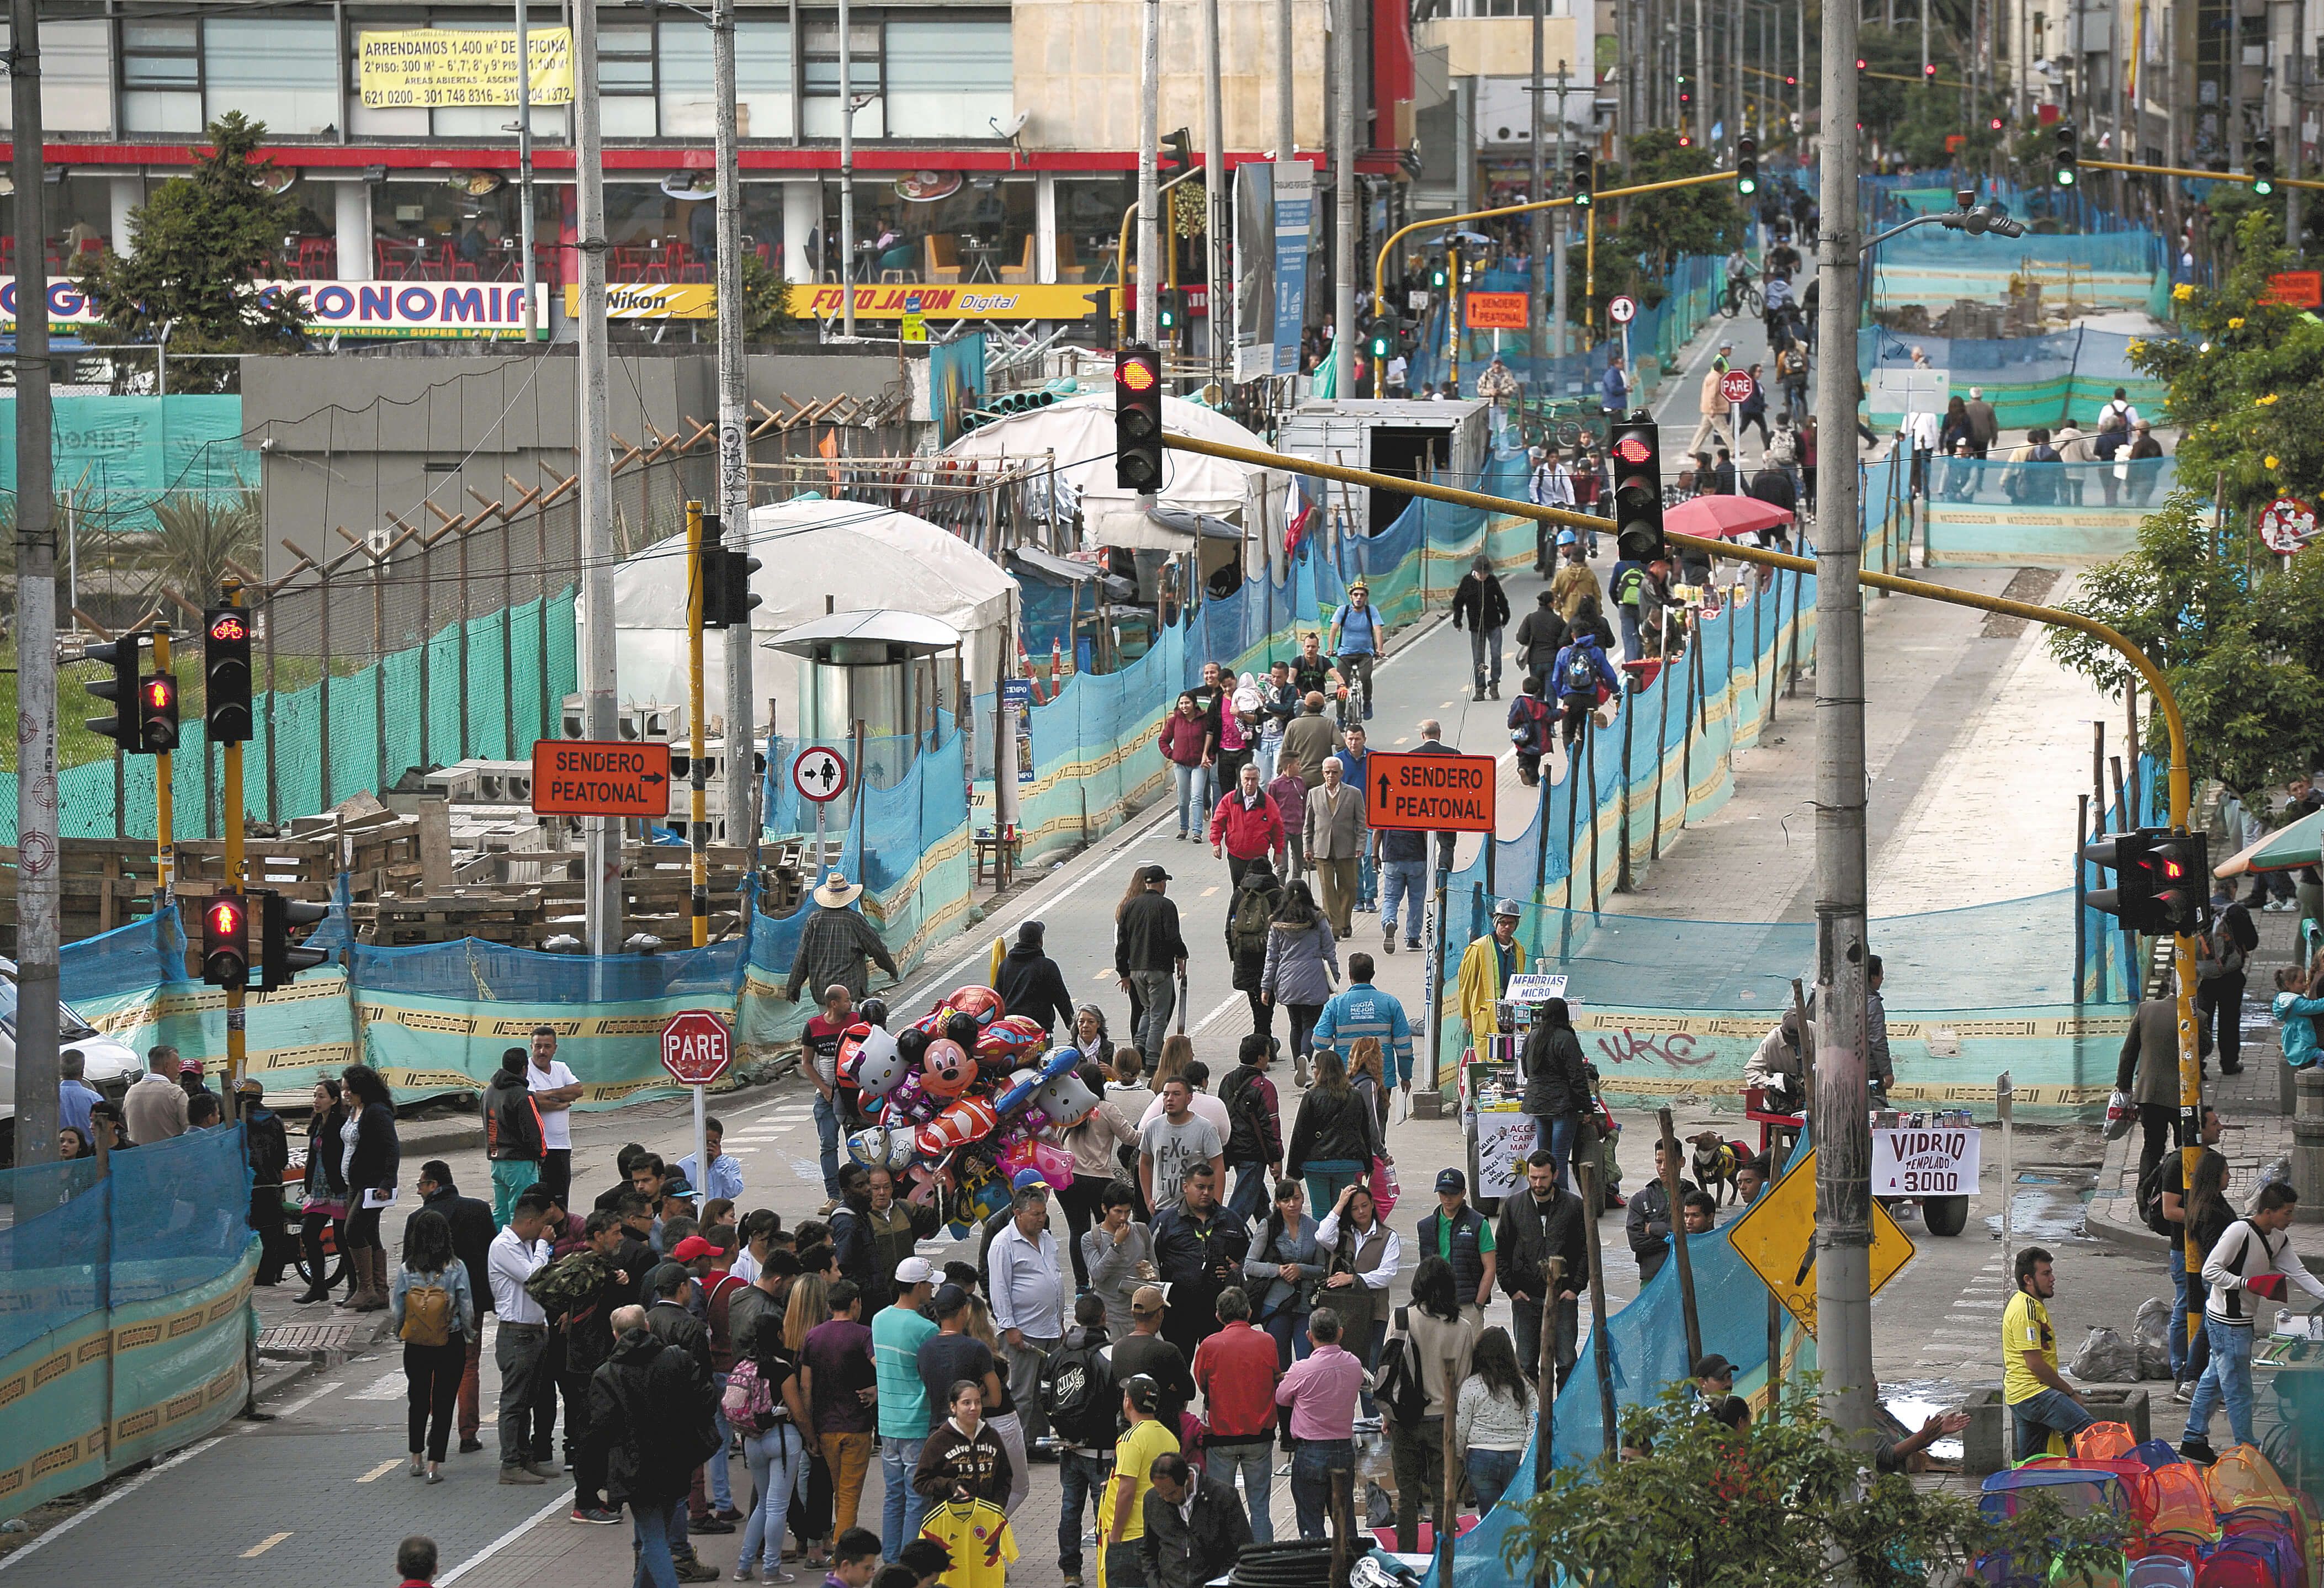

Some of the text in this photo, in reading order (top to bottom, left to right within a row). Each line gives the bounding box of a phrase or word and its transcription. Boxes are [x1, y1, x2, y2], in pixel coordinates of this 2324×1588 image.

[365, 41, 448, 56] ARRENDAMOS
[452, 40, 482, 55] 1.400
[501, 41, 516, 54] DE
[528, 39, 567, 54] FICINA
[402, 60, 420, 72] 300
[437, 76, 477, 84] ABIERTAS
[365, 90, 383, 104] 621
[388, 89, 412, 104] 0200
[425, 88, 442, 103] 301
[447, 88, 465, 103] 748
[469, 88, 493, 102] 8316
[546, 86, 570, 101] 1372
[606, 291, 666, 309] Nikon
[959, 294, 1018, 312] Digital
[410, 328, 458, 337] SUPER
[1723, 379, 1750, 392] PARE
[556, 751, 644, 772] SENDERO
[1400, 766, 1483, 789] SENDERO
[552, 781, 648, 803] PEATONAL
[1396, 796, 1486, 820] PEATONAL
[1521, 987, 1550, 997] MICRO
[405, 1016, 434, 1026] PELIGRO
[448, 1021, 466, 1029] PASE
[668, 1034, 723, 1061] PARE
[1479, 1134, 1497, 1151] SELFIES
[1890, 1133, 1966, 1162] VIDRIO
[1479, 1160, 1499, 1176] CABLES
[1487, 1170, 1505, 1185] DATOS
[1058, 1368, 1077, 1392] NIKE
